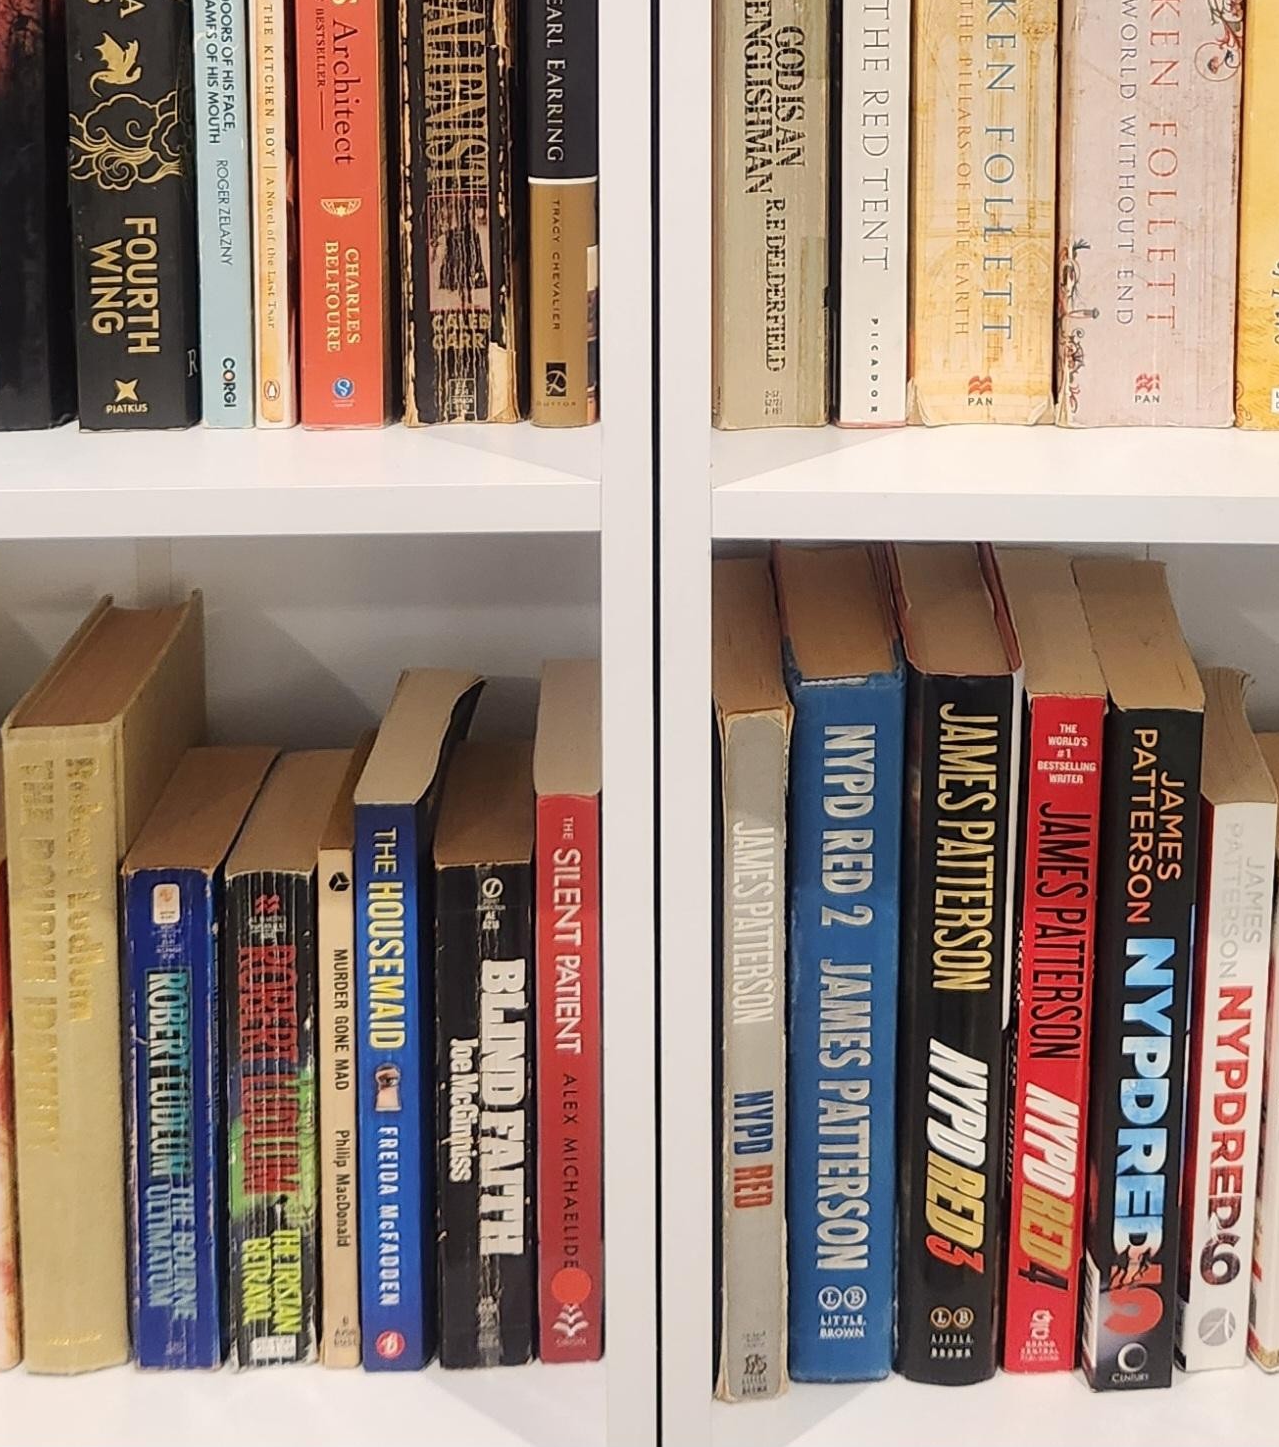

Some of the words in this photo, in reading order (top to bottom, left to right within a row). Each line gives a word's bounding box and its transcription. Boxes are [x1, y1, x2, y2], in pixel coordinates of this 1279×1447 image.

[332, 18, 356, 165] Architect
[546, 56, 567, 162] EARRING
[861, 89, 890, 160] RED
[1116, 114, 1138, 255] WITHOUT
[861, 169, 890, 272] TENT
[88, 238, 127, 335] WING
[121, 216, 161, 355] FOURTH
[1115, 268, 1134, 326] END
[106, 402, 148, 414] PIATKUS
[221, 357, 237, 409] CORGI
[1134, 395, 1160, 404] PAN
[823, 723, 876, 816] NYPD
[1038, 762, 1096, 772] BESTSELLING
[1049, 775, 1084, 784] WRITER
[373, 829, 397, 874] THE
[823, 829, 874, 893] RED
[552, 847, 583, 947] SILENT
[821, 906, 872, 926] 2
[332, 949, 347, 1007] MURDER
[366, 882, 407, 1051] HOUSEMAID
[334, 1010, 349, 1050] GONE
[552, 953, 583, 1053] PATIENT
[820, 960, 872, 1068] JAMES
[334, 1057, 349, 1091] MAD
[376, 1128, 398, 1196] FREIDA
[816, 1078, 872, 1272] PATTERSON
[821, 1328, 864, 1338] BROWN
